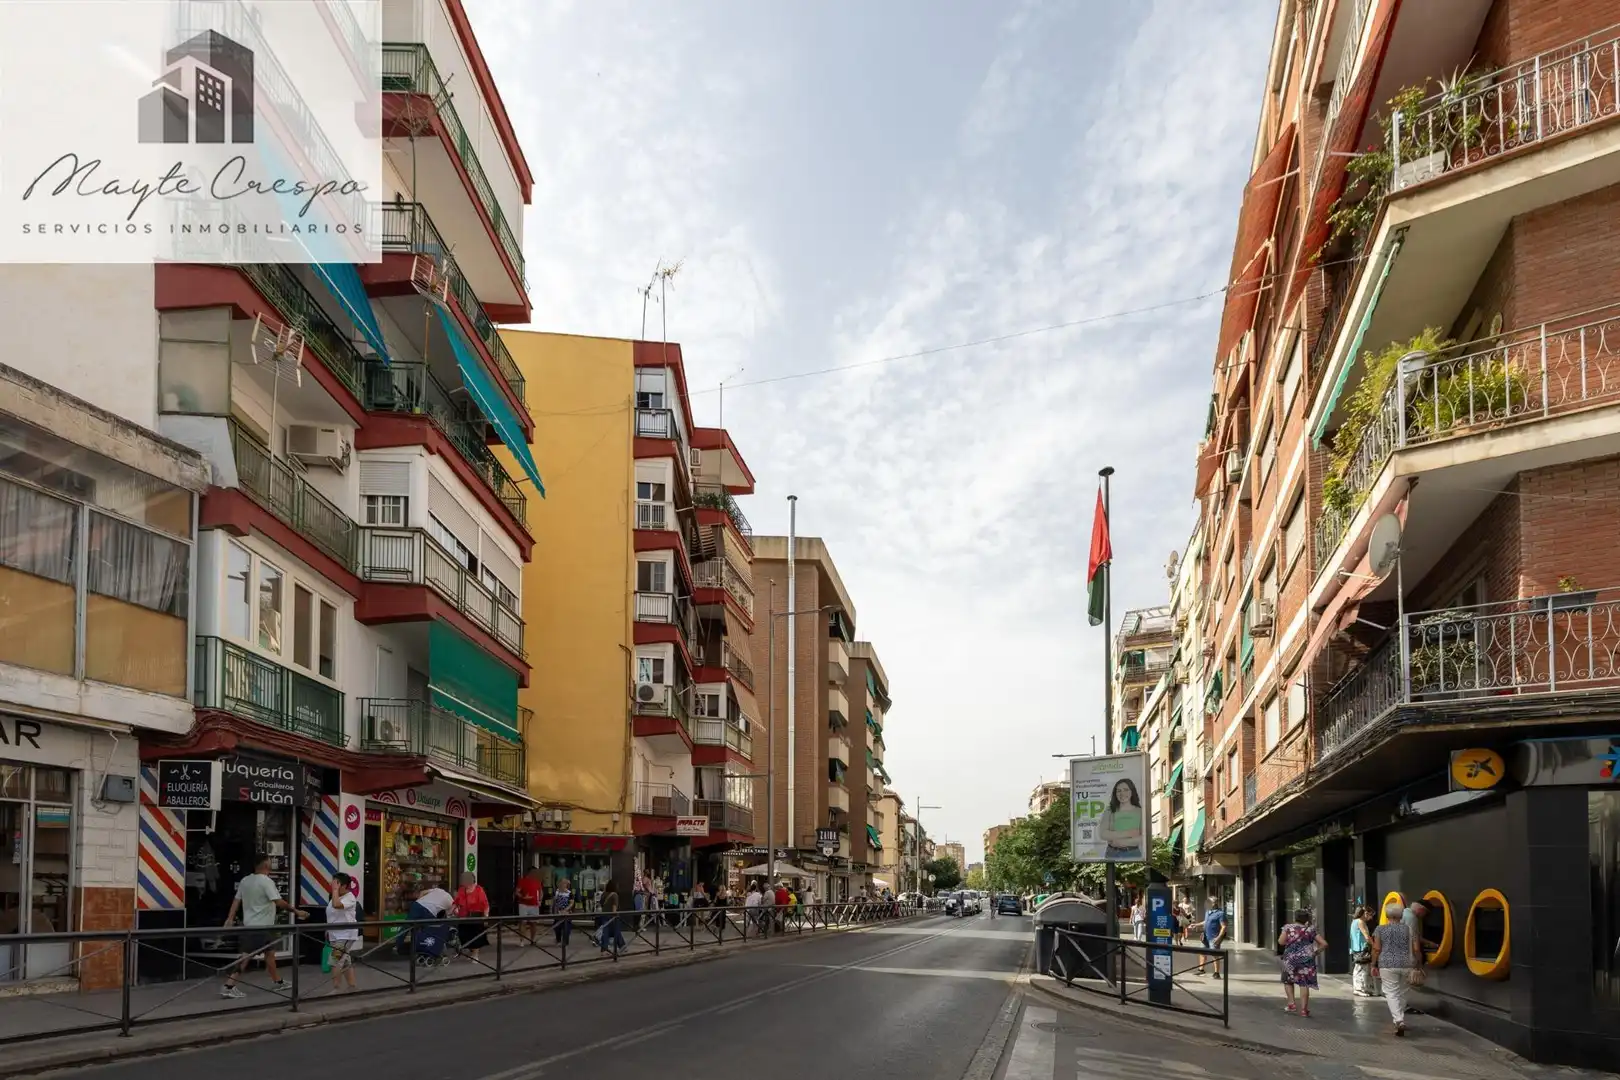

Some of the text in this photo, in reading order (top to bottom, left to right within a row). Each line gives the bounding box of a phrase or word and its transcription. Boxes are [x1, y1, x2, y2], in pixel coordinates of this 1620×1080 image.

[239, 787, 293, 805] Sultán
[1075, 791, 1089, 799] TU
[1075, 801, 1105, 819] FP
[1152, 898, 1165, 912] P
